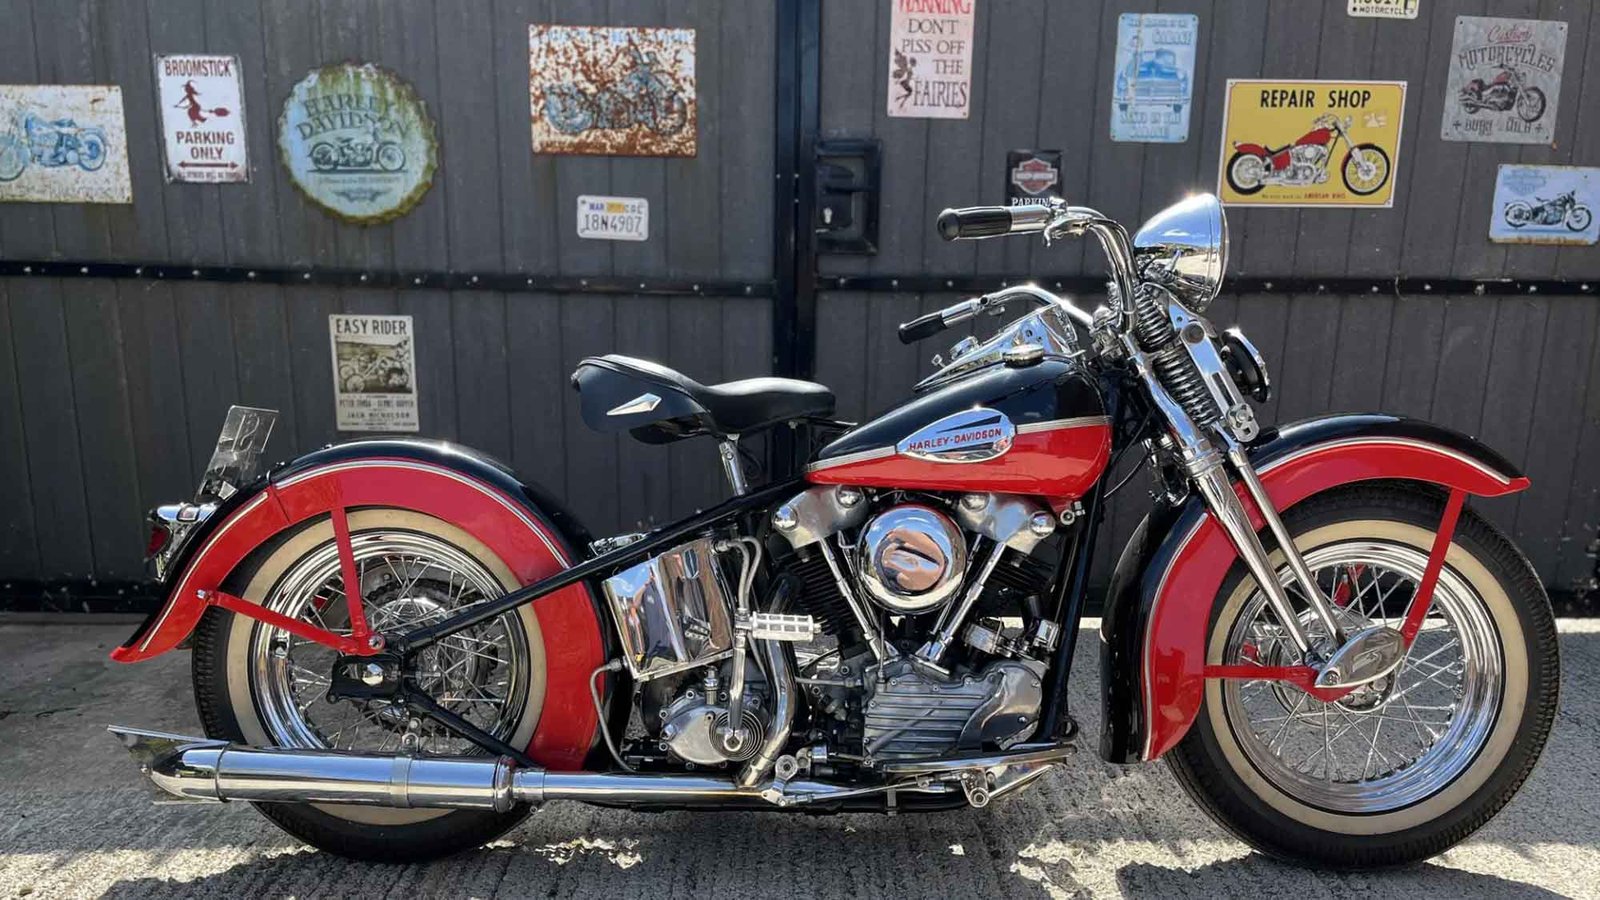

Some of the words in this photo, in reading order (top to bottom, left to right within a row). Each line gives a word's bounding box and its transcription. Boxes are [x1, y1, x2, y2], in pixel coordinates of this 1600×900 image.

[908, 18, 959, 34] DON'T
[902, 39, 931, 53] PISS
[937, 40, 965, 54] OFF
[1458, 44, 1555, 72] MOTORCYCLES
[165, 60, 232, 76] BROOMSTICK
[932, 60, 963, 75] THE
[913, 81, 968, 108] FAIRIES
[1260, 90, 1315, 108] REPAIR
[1328, 90, 1371, 108] SHOP
[176, 131, 235, 144] PARKING
[190, 147, 223, 160] ONLY
[1011, 197, 1051, 207] PARKIN
[585, 214, 642, 232] 18N4907
[336, 319, 368, 334] EASY
[372, 320, 407, 335] RIDER
[909, 428, 1002, 450] HARLEY-DAVIDSON
